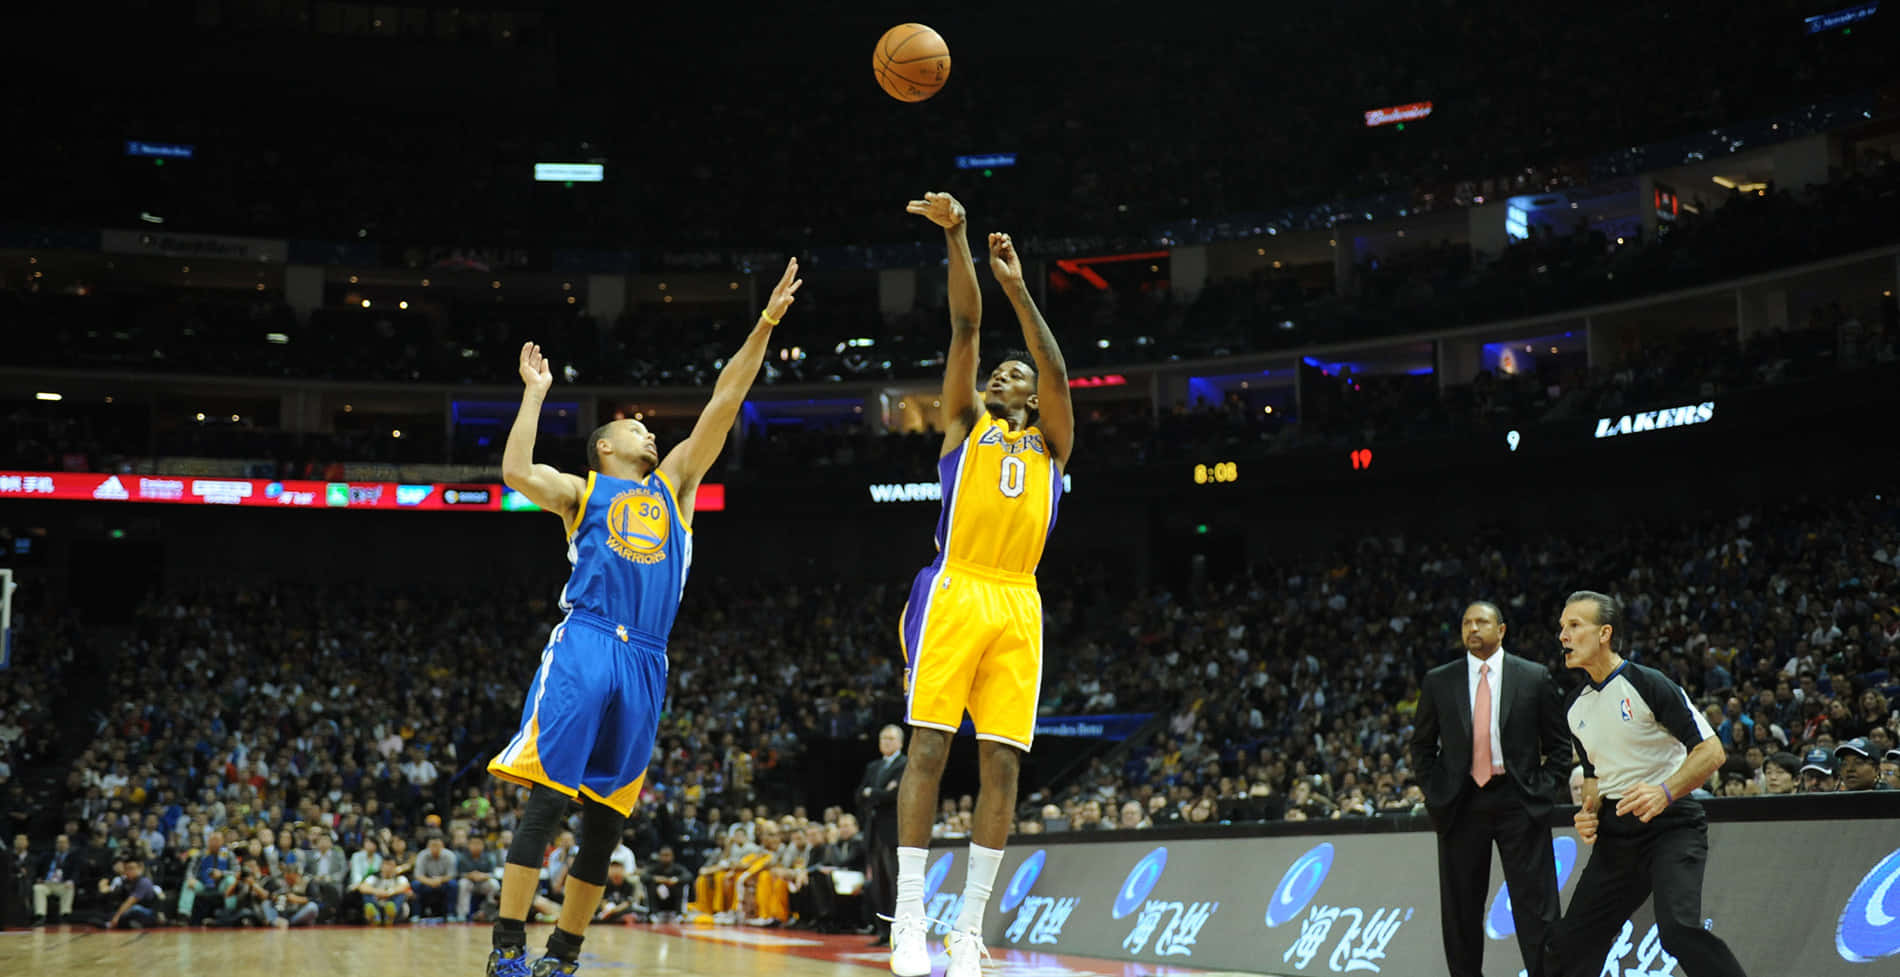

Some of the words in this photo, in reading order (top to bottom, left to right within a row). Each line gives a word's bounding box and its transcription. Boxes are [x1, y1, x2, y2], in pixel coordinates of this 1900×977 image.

[1594, 401, 1715, 438] LAKERS
[1506, 430, 1520, 451] 9
[1350, 448, 1373, 470] 19
[999, 455, 1026, 498] 0
[869, 482, 942, 502] WARRI
[638, 503, 661, 520] 30
[606, 536, 666, 564] WARRIORS
[1122, 900, 1210, 955] 海飞丝
[1282, 904, 1401, 973] 海飞丝
